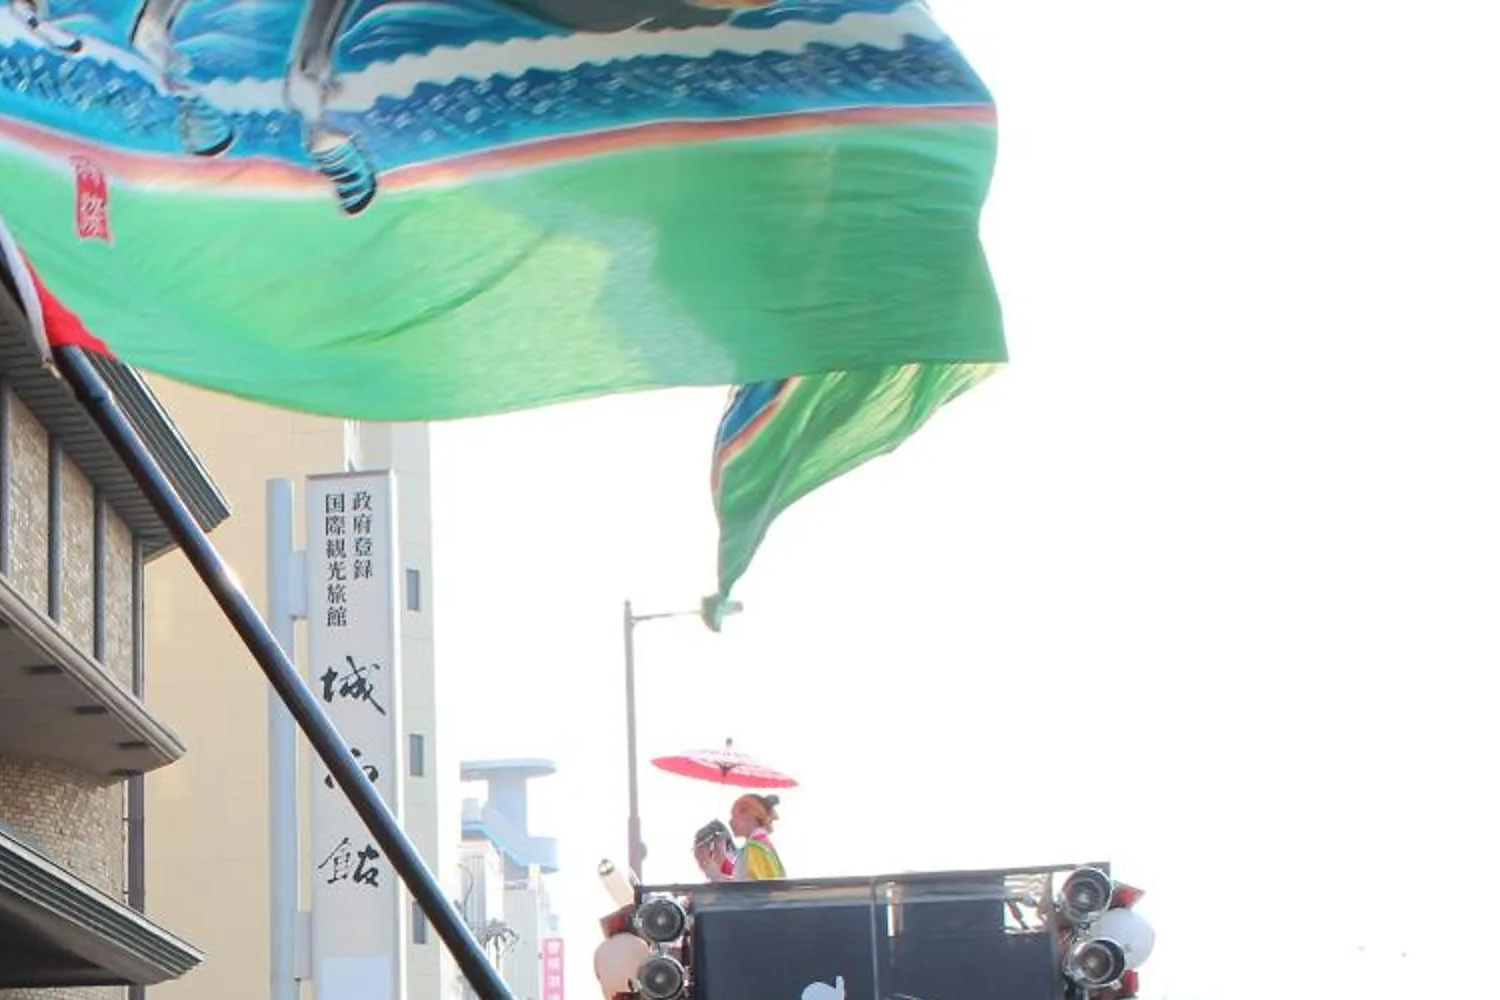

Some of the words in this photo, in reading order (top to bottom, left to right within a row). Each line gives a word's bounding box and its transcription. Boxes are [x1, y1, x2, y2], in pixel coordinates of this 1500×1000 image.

[325, 492, 347, 627] 国際観光旅館
[352, 490, 373, 580] 政府登録
